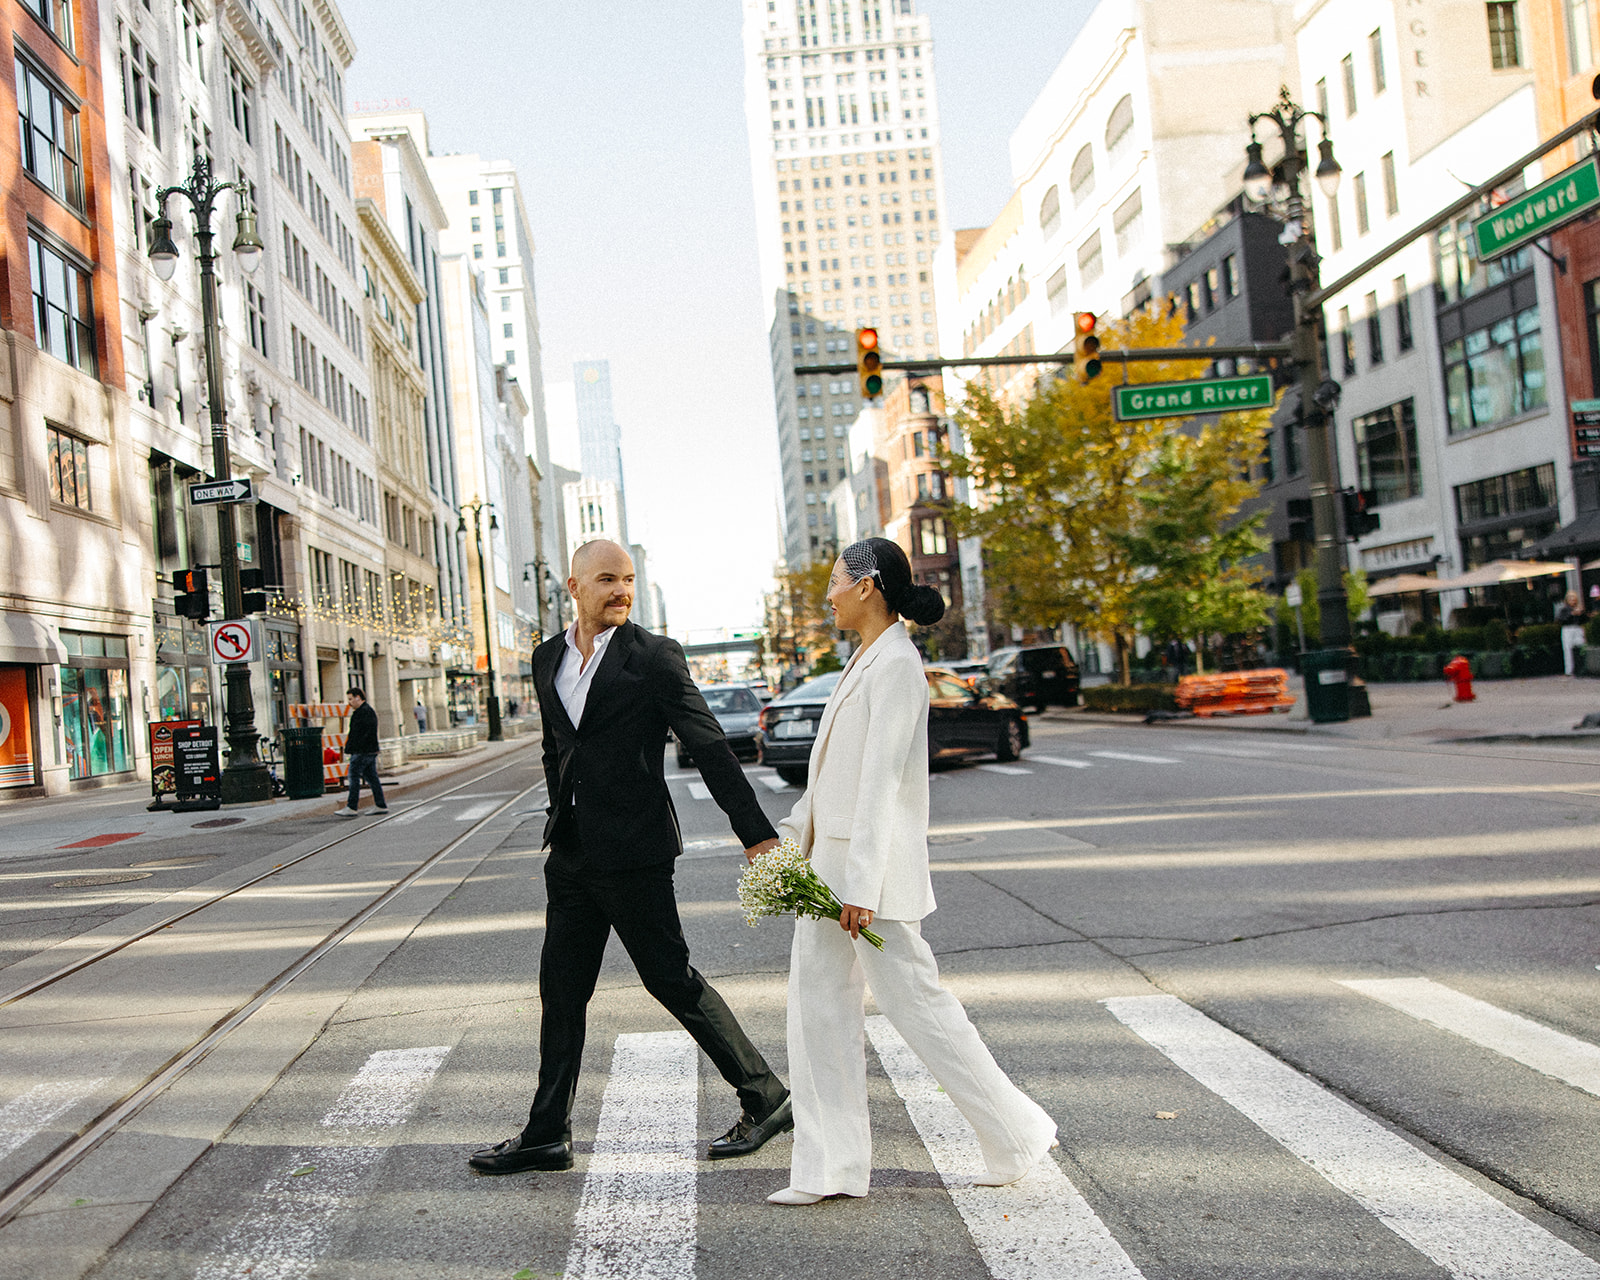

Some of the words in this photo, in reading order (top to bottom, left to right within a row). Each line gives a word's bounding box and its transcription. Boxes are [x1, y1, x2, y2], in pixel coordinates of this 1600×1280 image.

[354, 97, 411, 112] BUILDING
[1491, 178, 1578, 241] Woodward
[1130, 390, 1192, 410] Grand
[1202, 385, 1259, 403] River
[196, 489, 215, 499] ONE
[216, 486, 234, 496] WAY
[177, 741, 192, 749] SHOP
[192, 739, 213, 749] DETROIT
